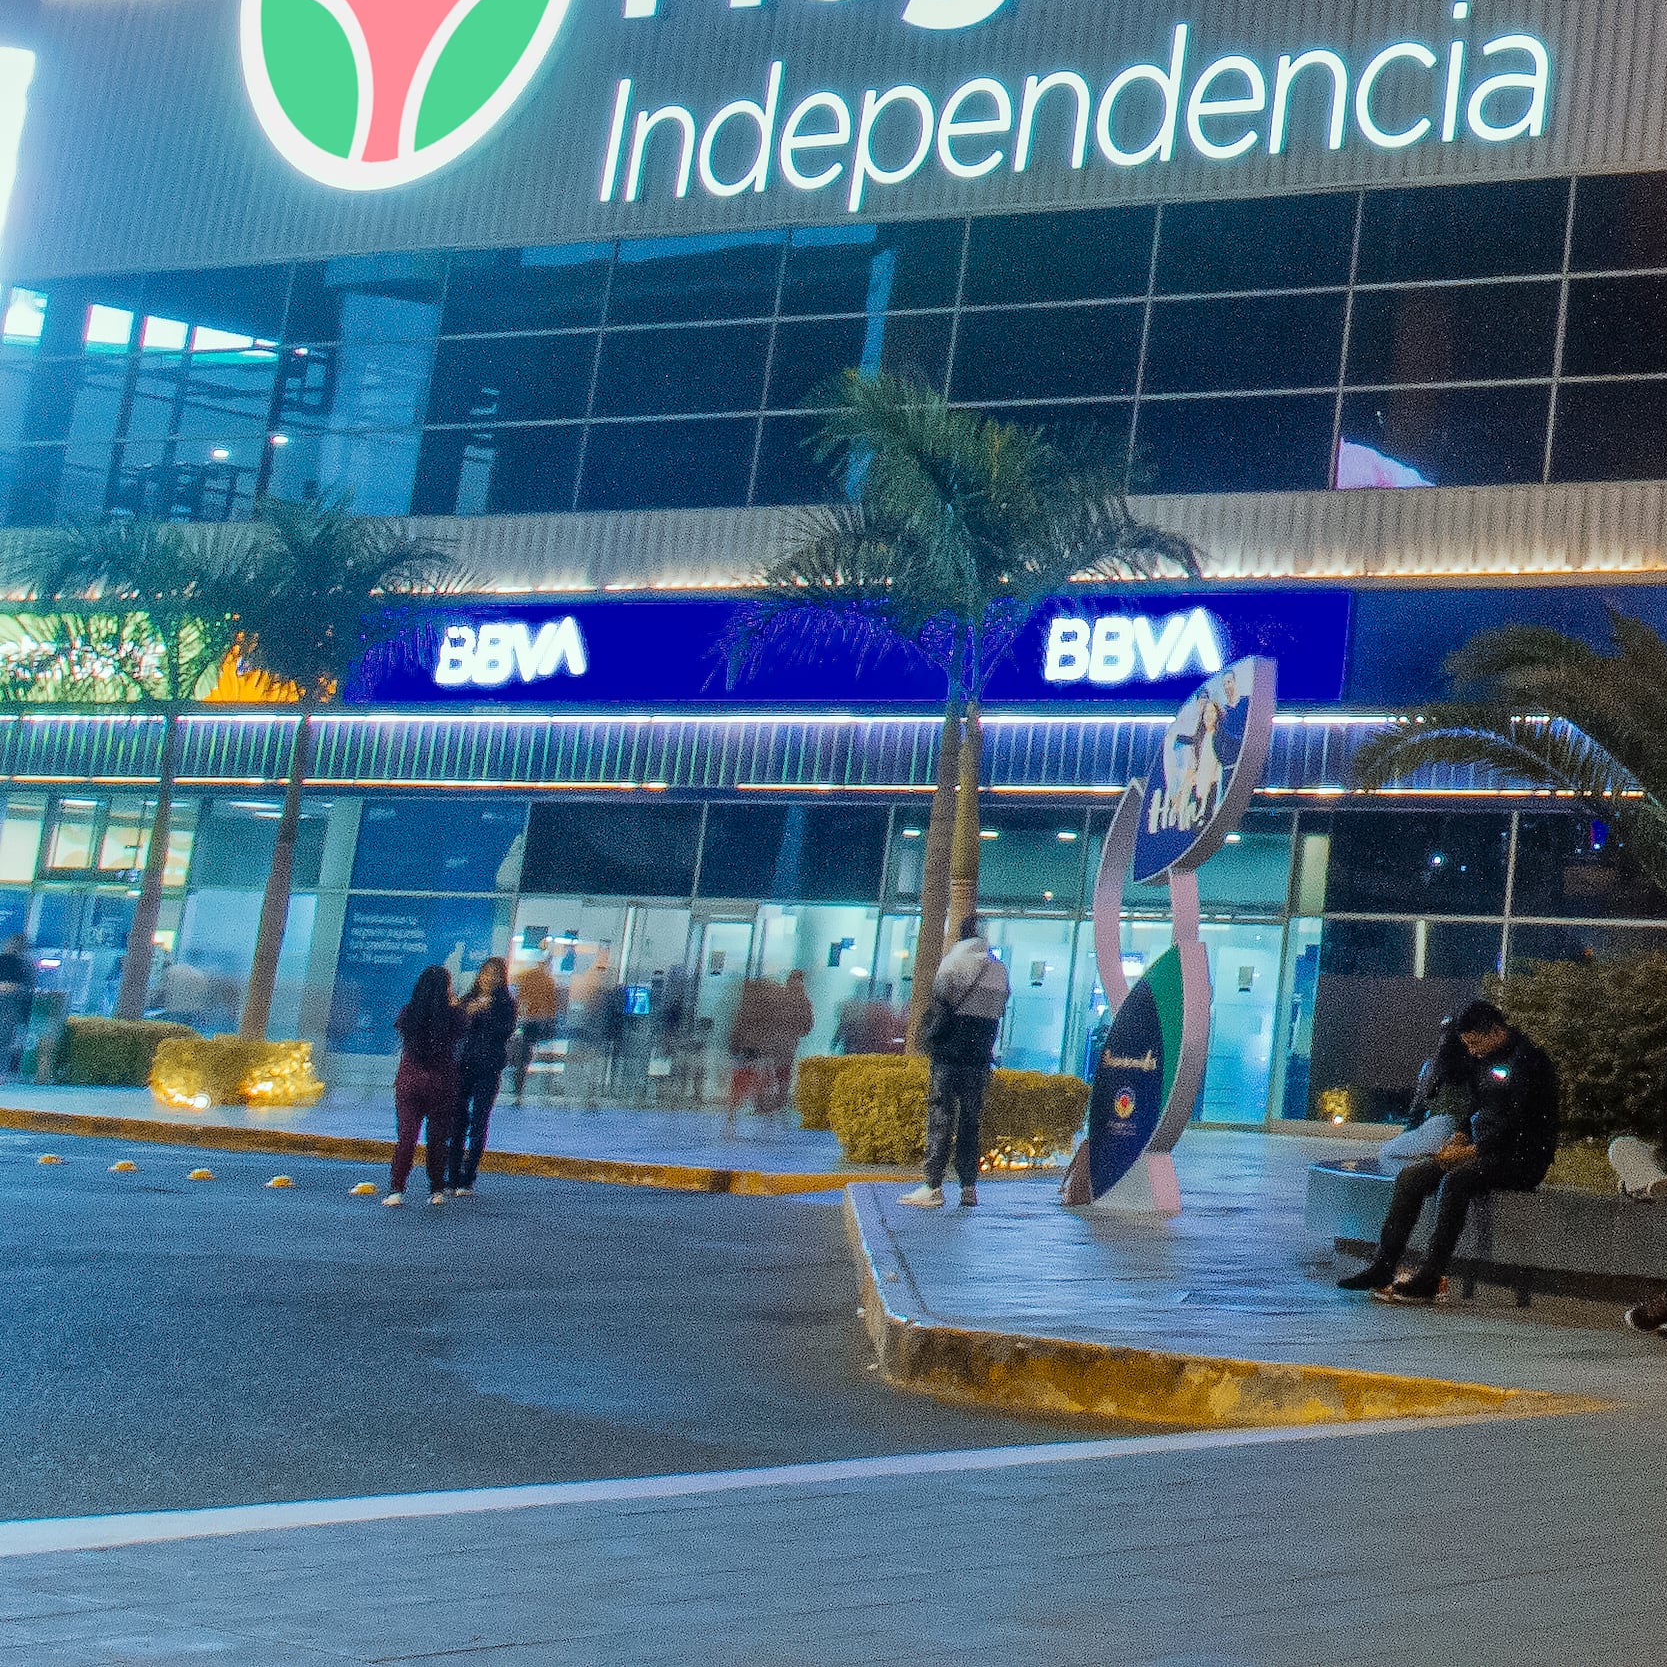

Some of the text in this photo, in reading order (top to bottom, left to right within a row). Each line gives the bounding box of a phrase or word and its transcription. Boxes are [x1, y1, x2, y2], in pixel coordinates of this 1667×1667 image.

[601, 2, 1553, 213] Independencia
[436, 617, 586, 686] BBVA
[1043, 608, 1224, 684] BBVA
